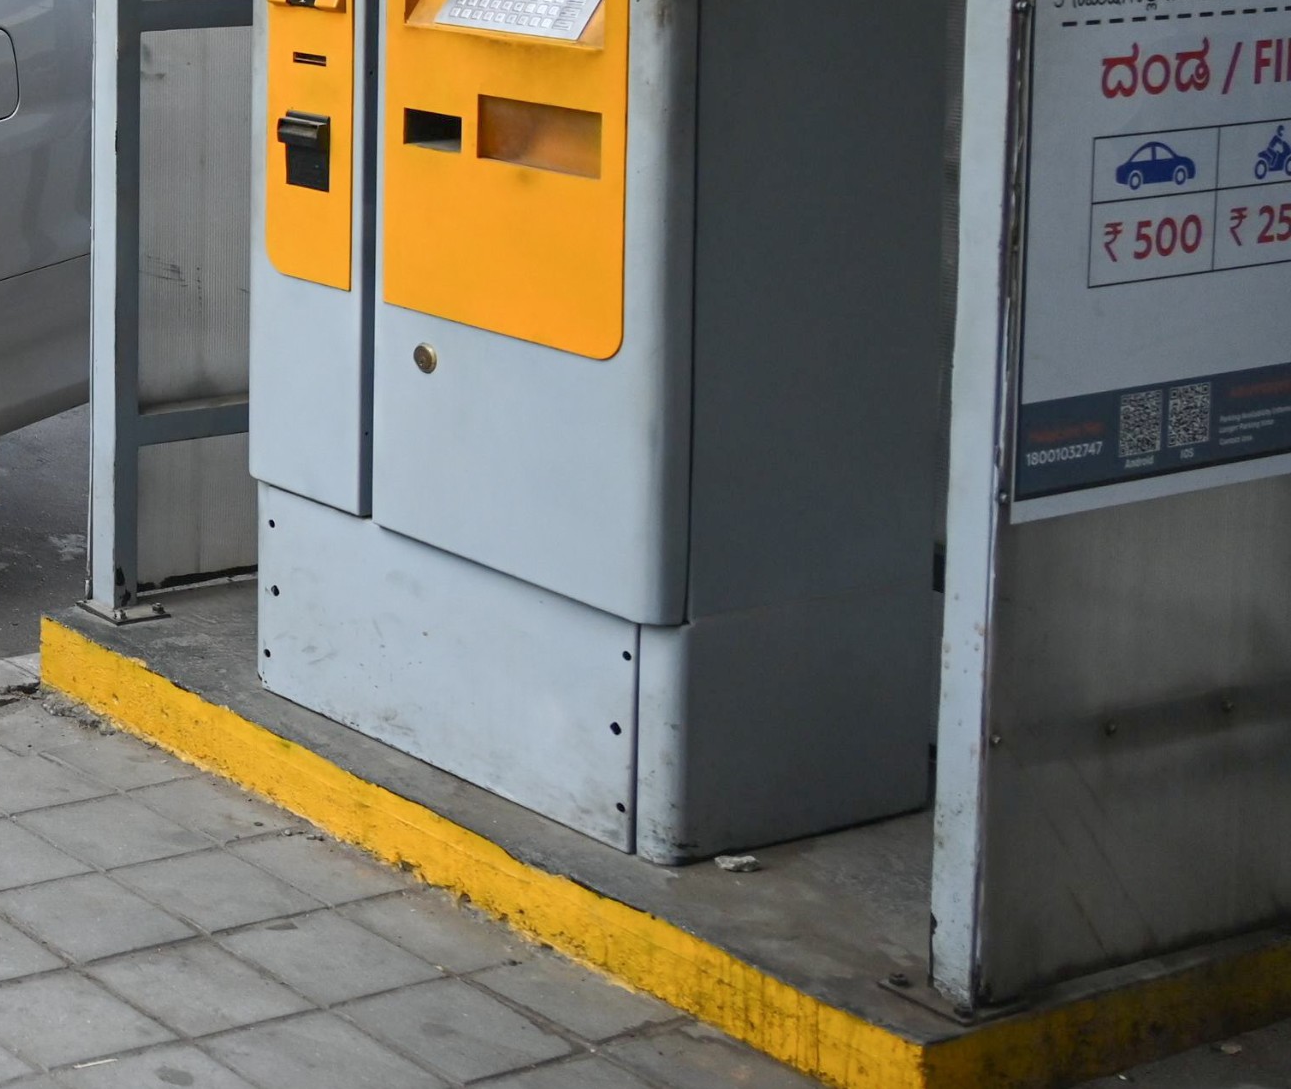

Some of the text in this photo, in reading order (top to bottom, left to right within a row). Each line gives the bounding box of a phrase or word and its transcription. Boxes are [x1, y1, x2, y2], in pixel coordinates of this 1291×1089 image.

[1101, 36, 1210, 98] ದಂಡ
[1254, 38, 1291, 84] FI
[1026, 441, 1103, 466] 18001032747
